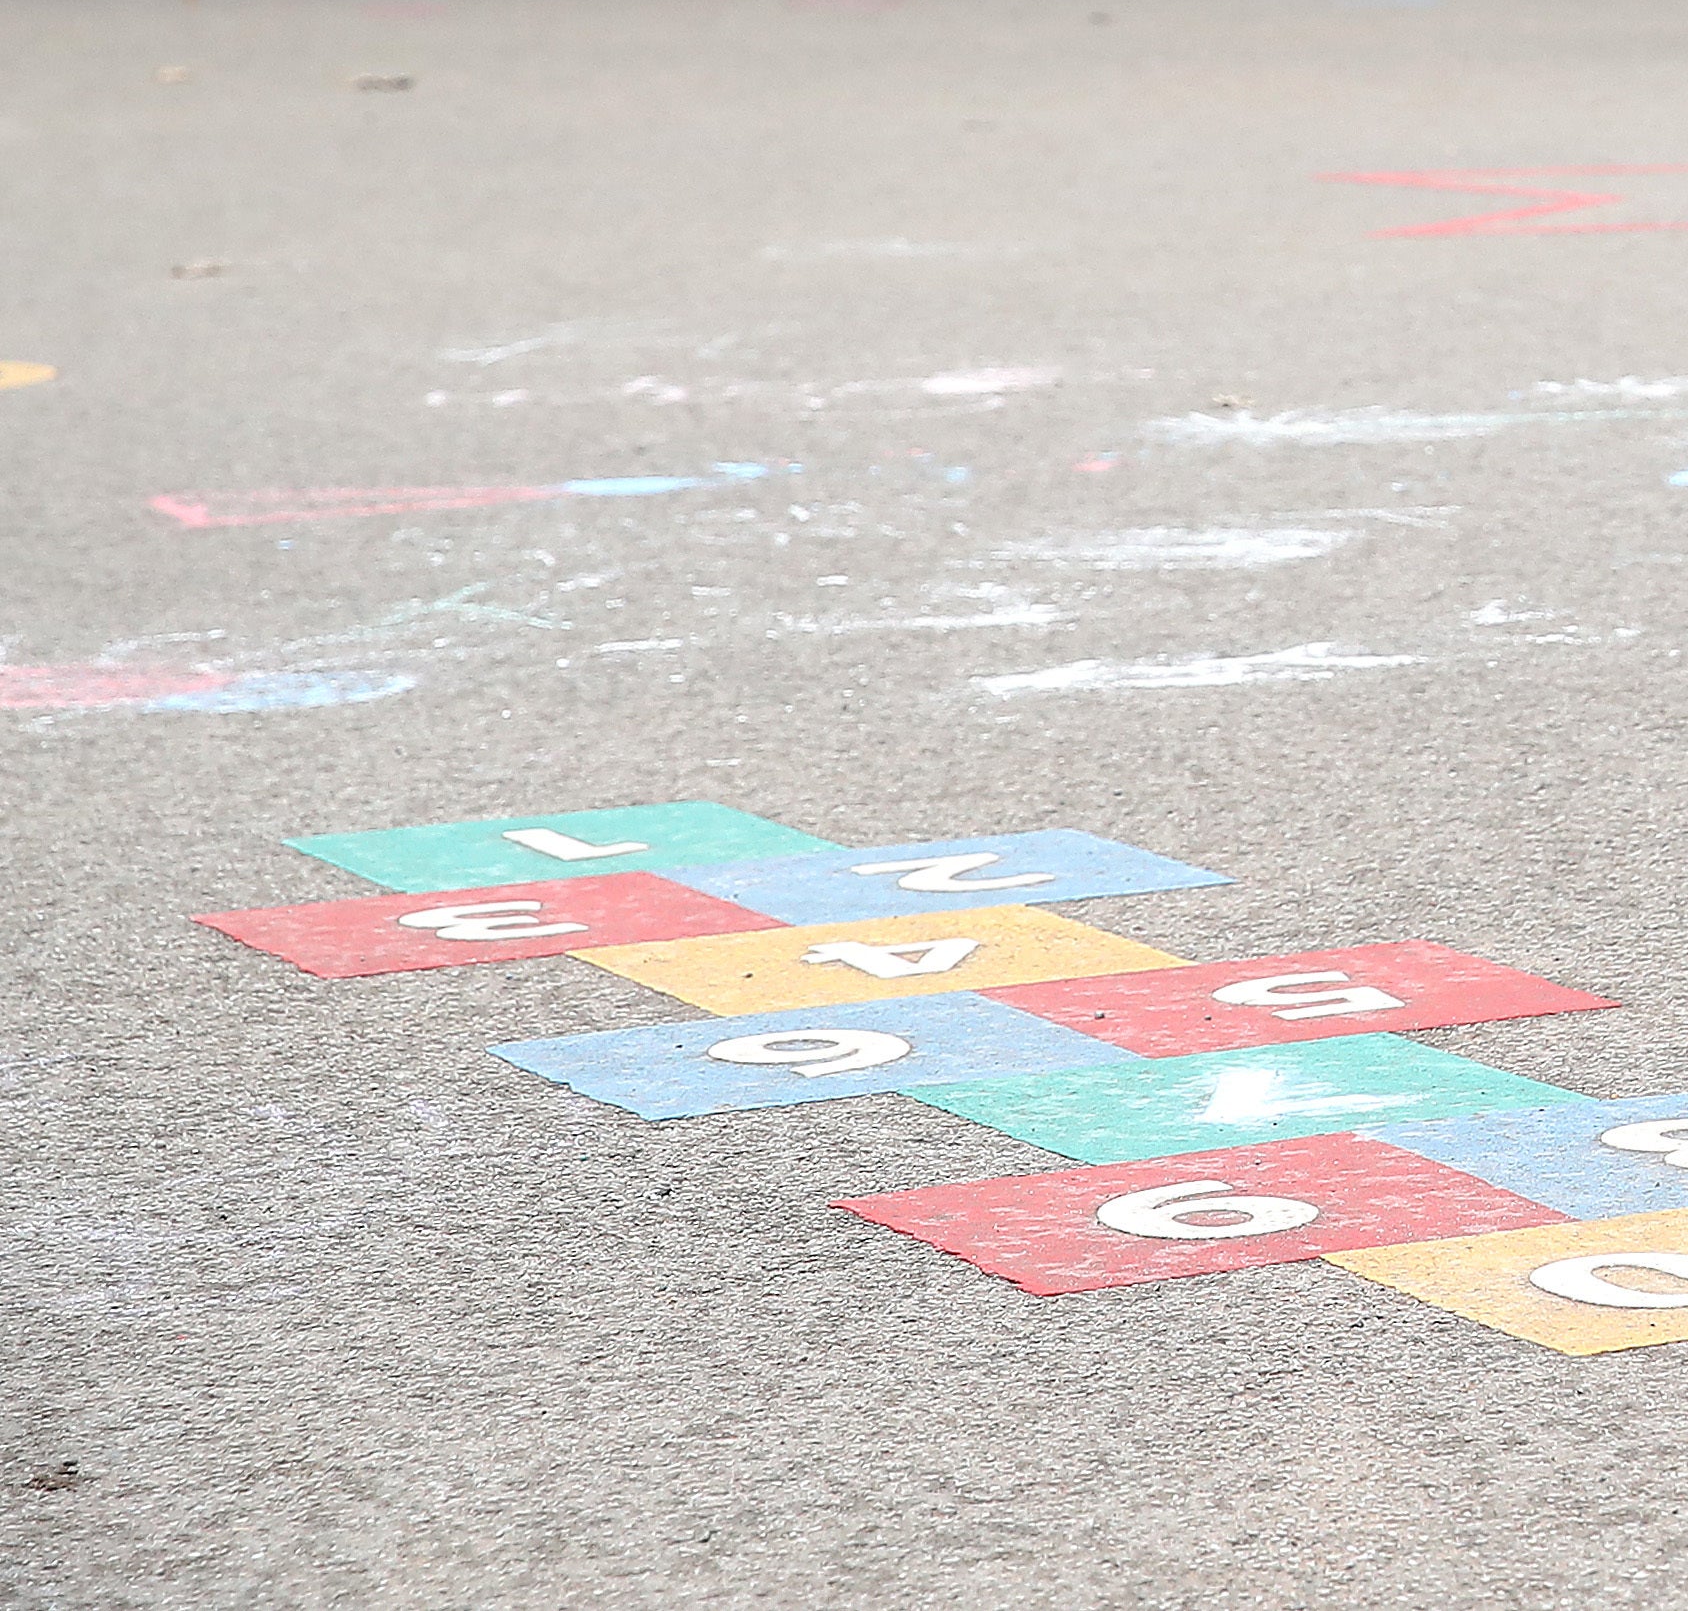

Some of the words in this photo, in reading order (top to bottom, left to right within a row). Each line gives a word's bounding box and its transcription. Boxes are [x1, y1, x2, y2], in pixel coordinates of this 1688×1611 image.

[502, 827, 652, 862] 1
[850, 851, 1056, 893] 2
[399, 900, 590, 941] 3
[800, 937, 981, 980] 4
[1209, 970, 1406, 1022] 5
[705, 1028, 912, 1078] 6
